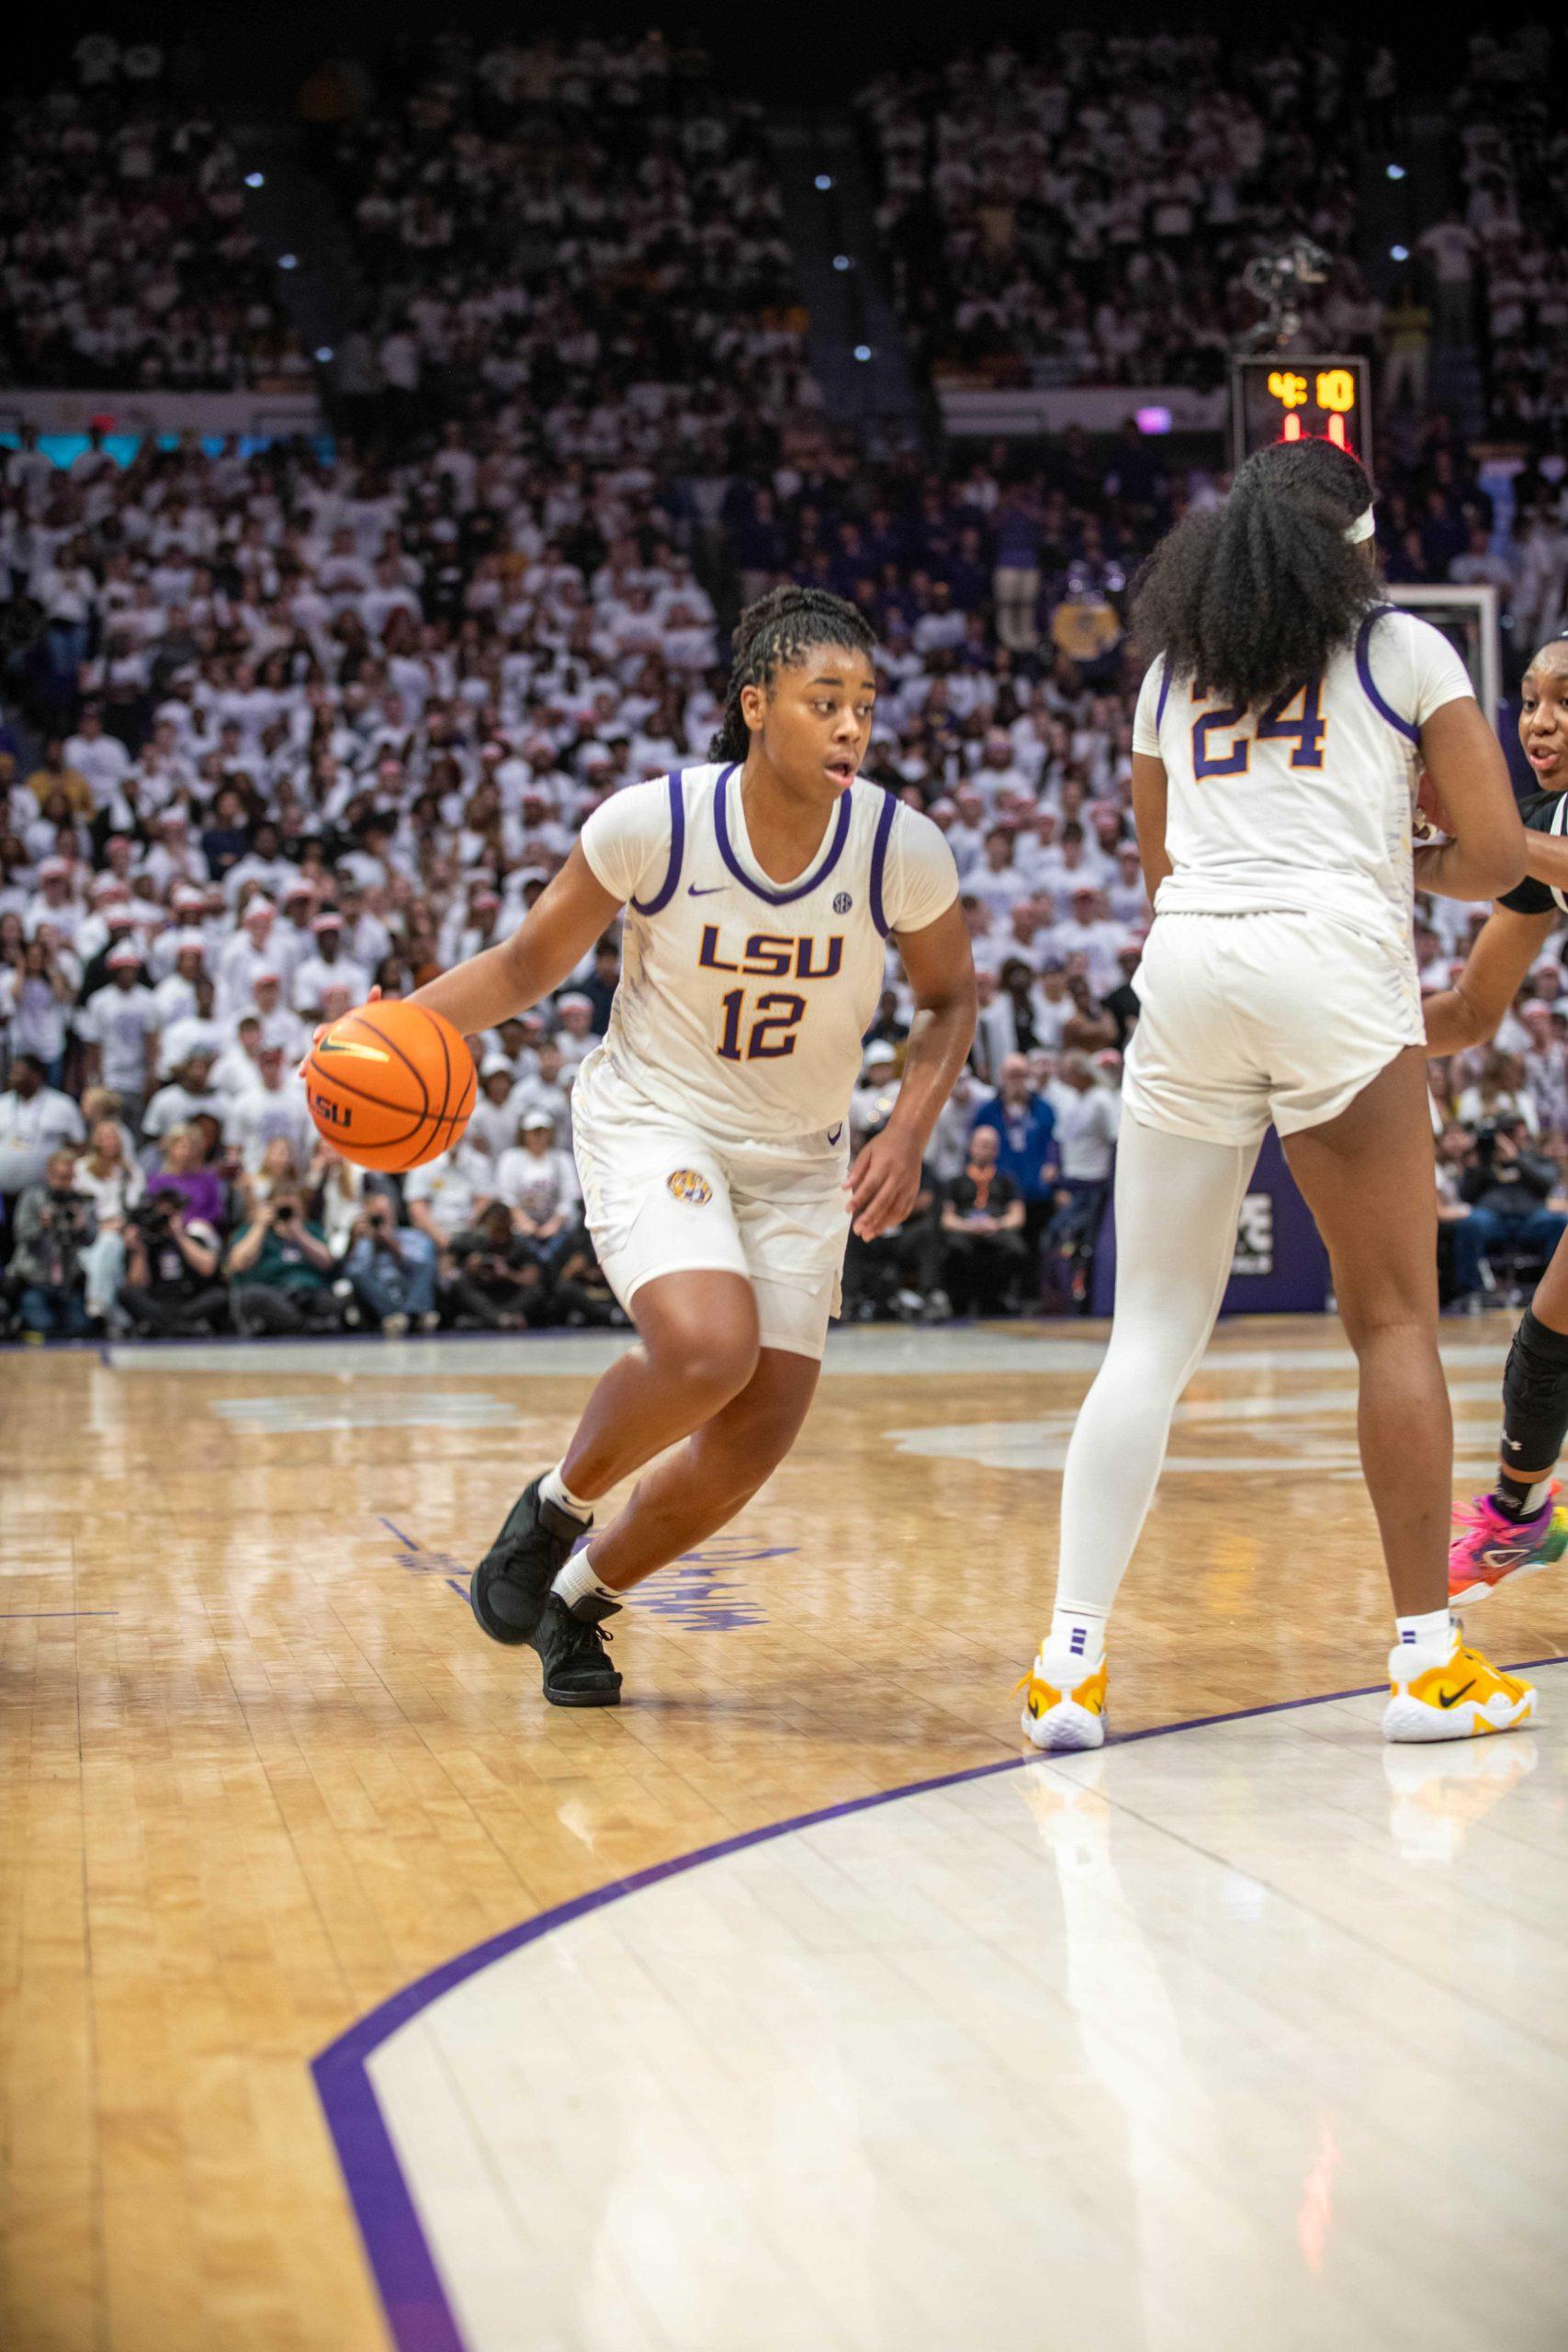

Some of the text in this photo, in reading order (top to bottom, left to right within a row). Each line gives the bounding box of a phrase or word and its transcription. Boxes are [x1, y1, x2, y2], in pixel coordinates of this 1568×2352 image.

[1191, 675, 1327, 785] 24
[698, 923, 844, 979] LSU
[716, 988, 807, 1060] 12
